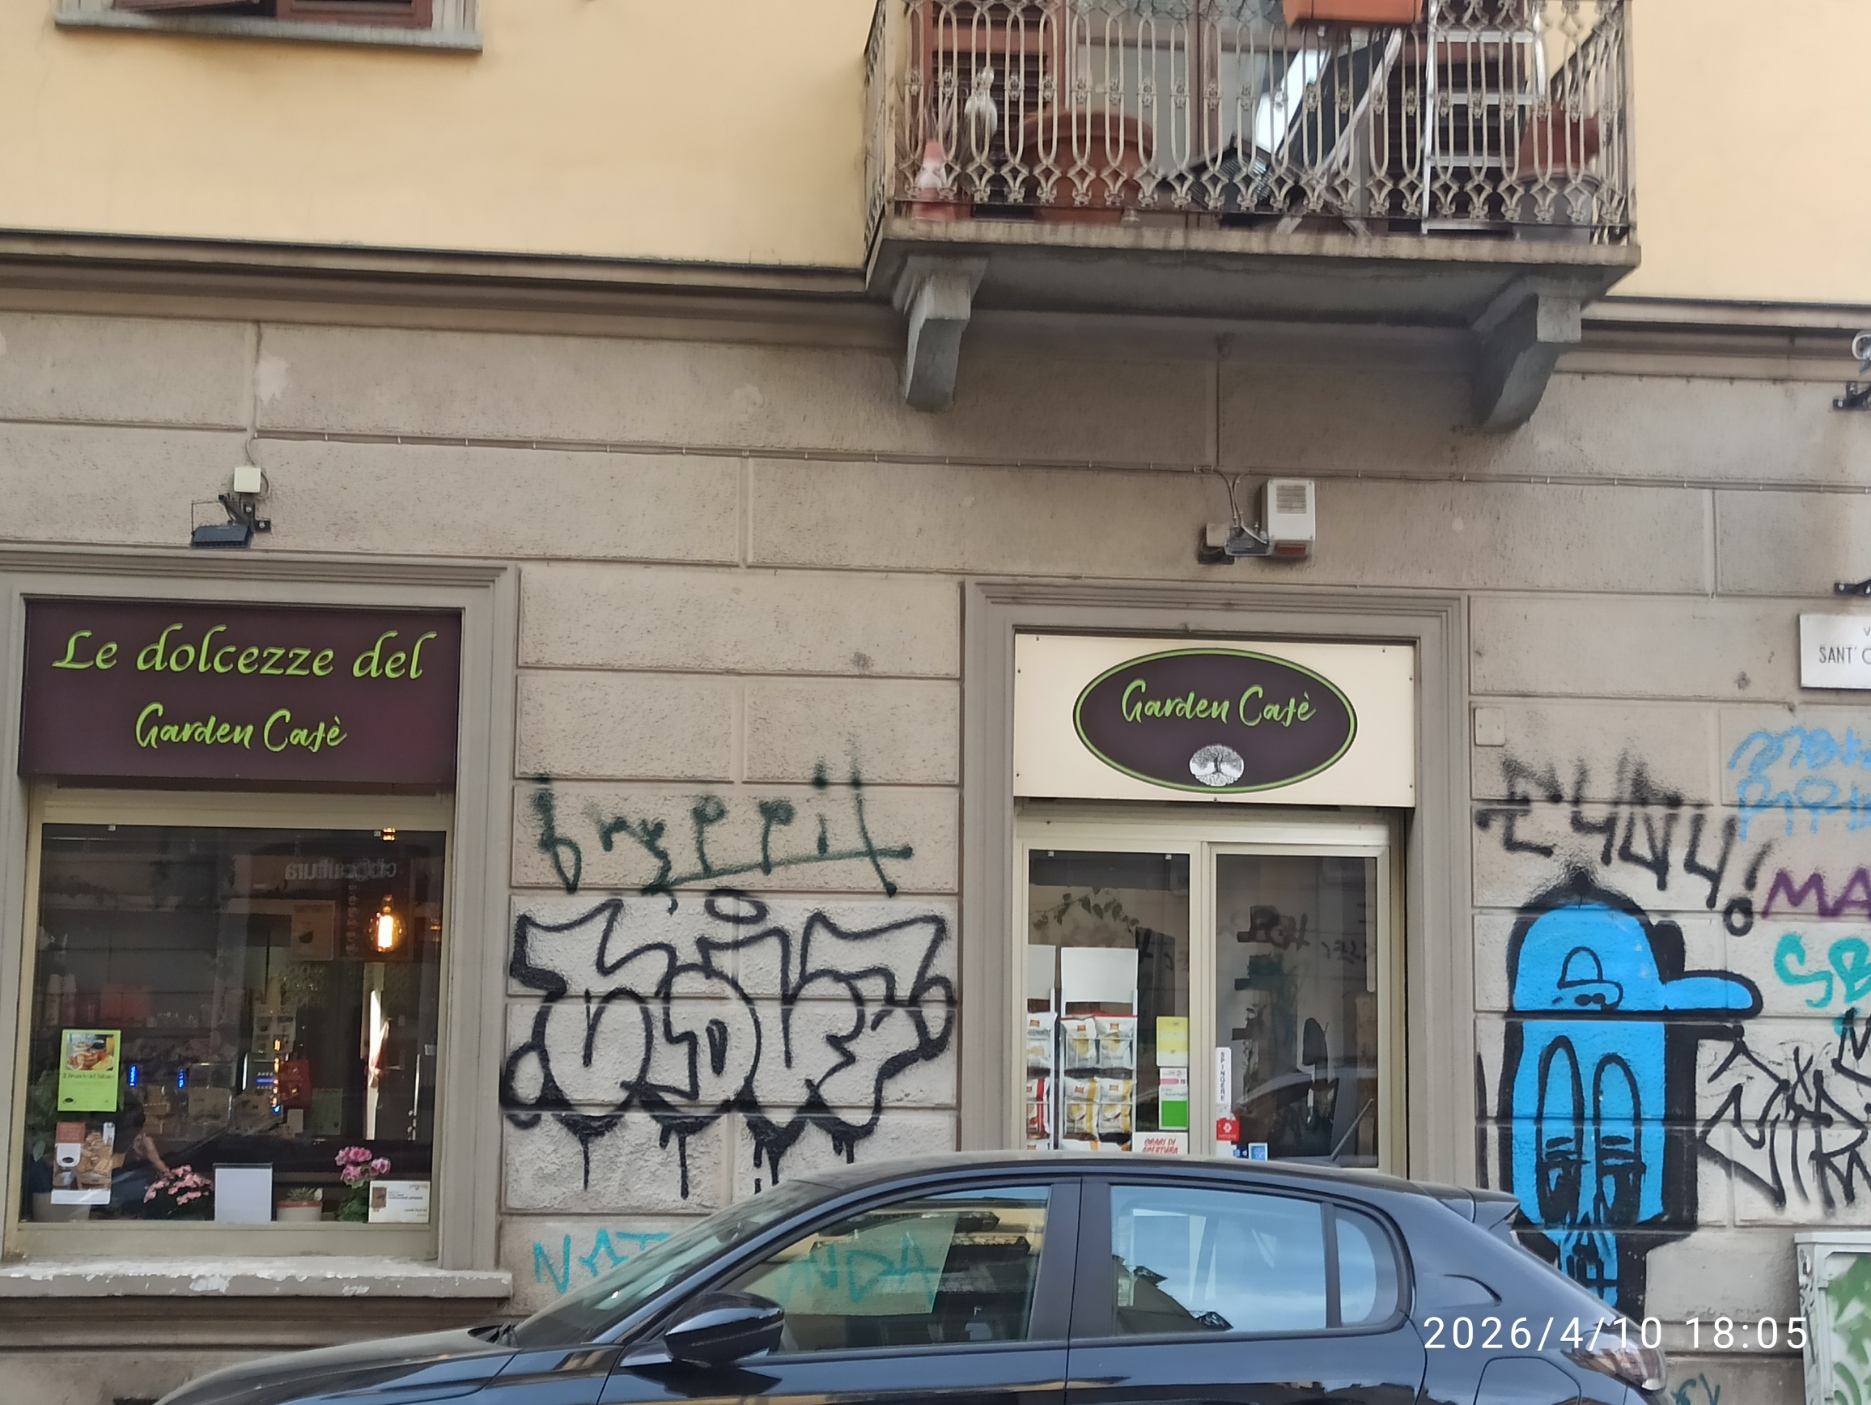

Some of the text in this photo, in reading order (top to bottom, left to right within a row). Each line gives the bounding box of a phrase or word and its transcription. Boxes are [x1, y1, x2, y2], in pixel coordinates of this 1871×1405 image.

[53, 623, 437, 680] Le dolcezze del
[135, 702, 347, 753] Garden Cafè
[1121, 678, 1317, 728] Garden Cafè
